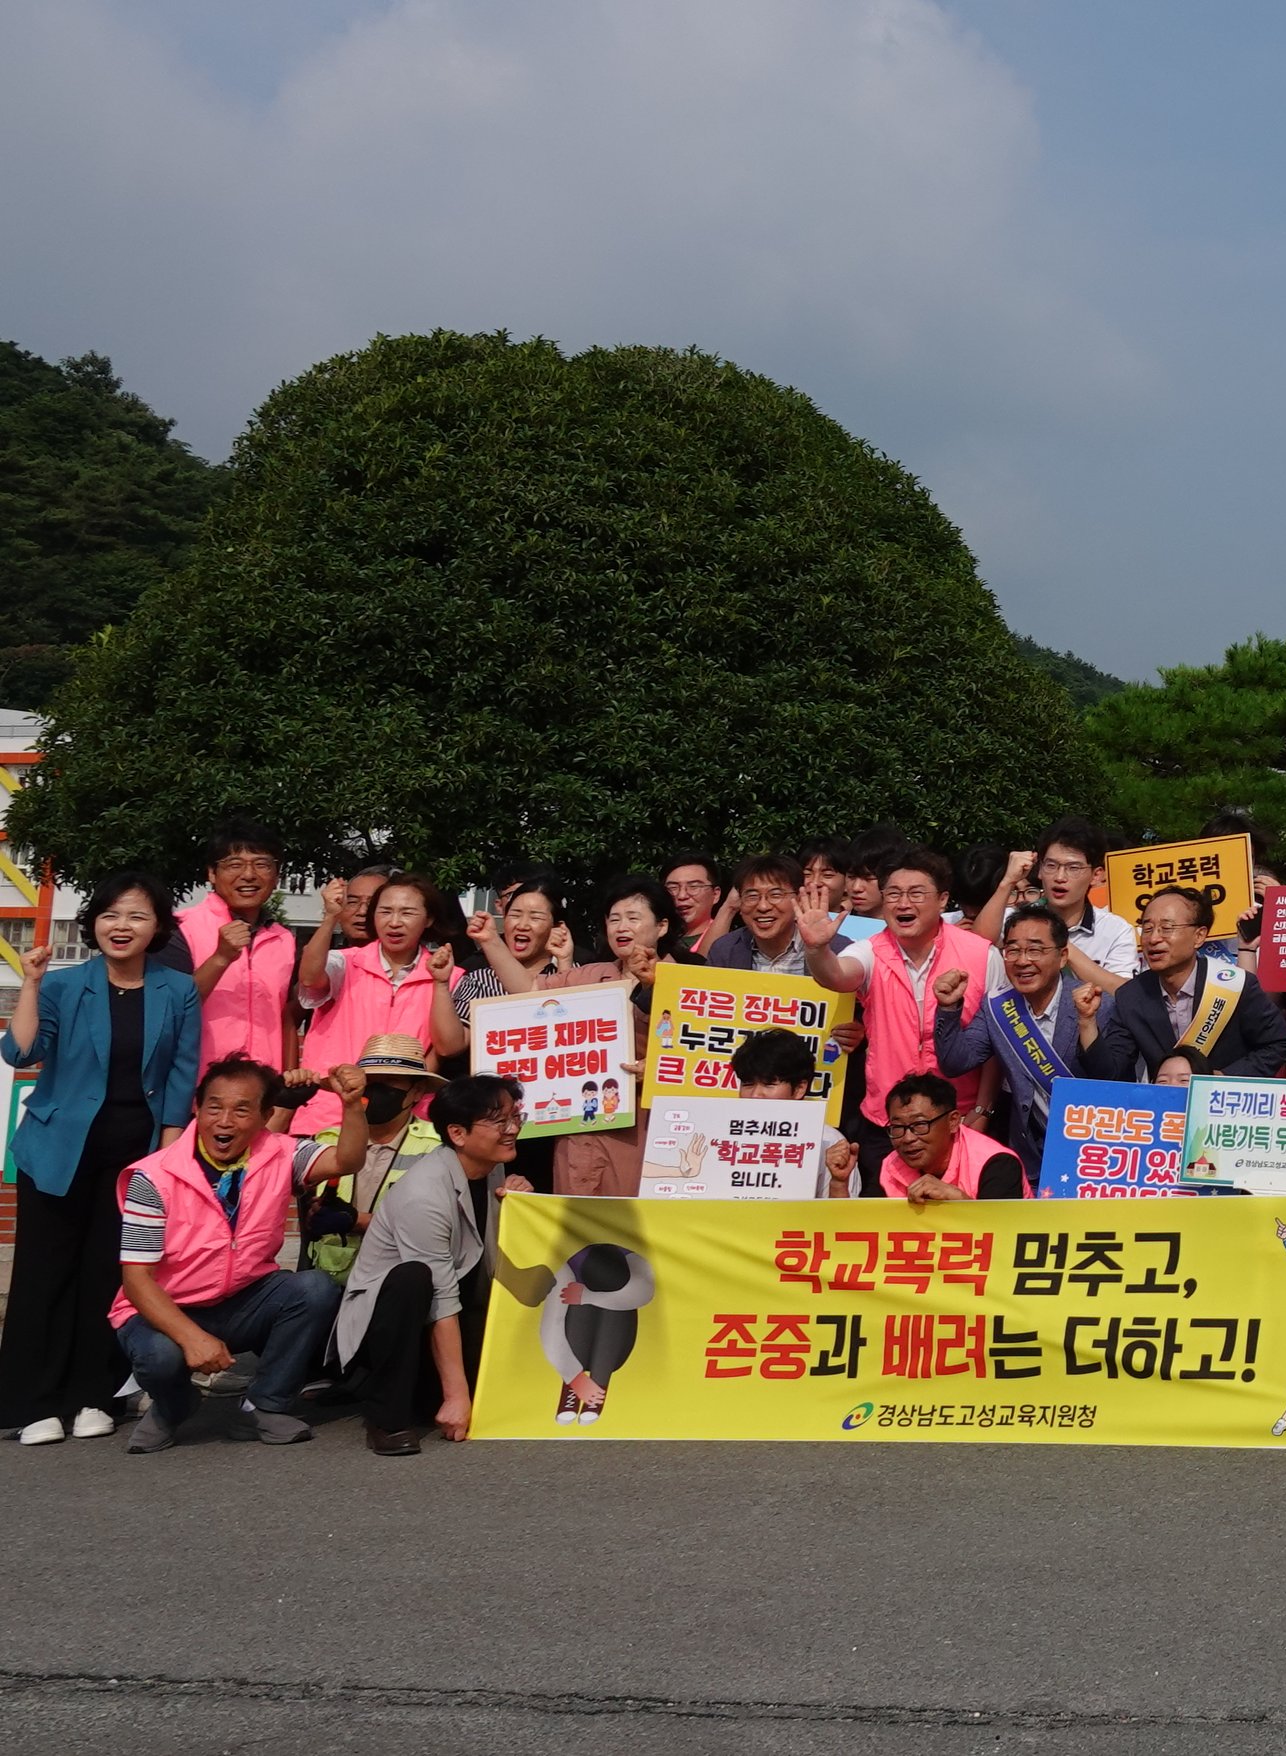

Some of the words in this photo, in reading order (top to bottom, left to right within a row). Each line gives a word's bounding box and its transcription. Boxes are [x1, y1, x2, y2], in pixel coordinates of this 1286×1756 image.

[1132, 854, 1220, 888] 학교폭력
[680, 989, 735, 1019] 작은
[744, 994, 827, 1028] 장난이
[545, 1049, 607, 1079] 어린이
[658, 1056, 686, 1084] 큰
[1209, 1090, 1275, 1117] 친구끼리
[730, 1120, 799, 1137] 멈추세요!
[1065, 1105, 1153, 1142] 방관도
[1204, 1124, 1271, 1150] 사랑가득
[1078, 1146, 1140, 1180] 용기
[731, 1171, 782, 1188] 입니다.
[774, 1231, 994, 1296] 학교폭력
[1013, 1232, 1199, 1299] 멈추고,
[704, 1314, 867, 1379] 존중과
[881, 1315, 1042, 1379] 배려는
[1066, 1317, 1262, 1383] 더하고!
[877, 1405, 1097, 1430] 경상남도고성교육지원청
